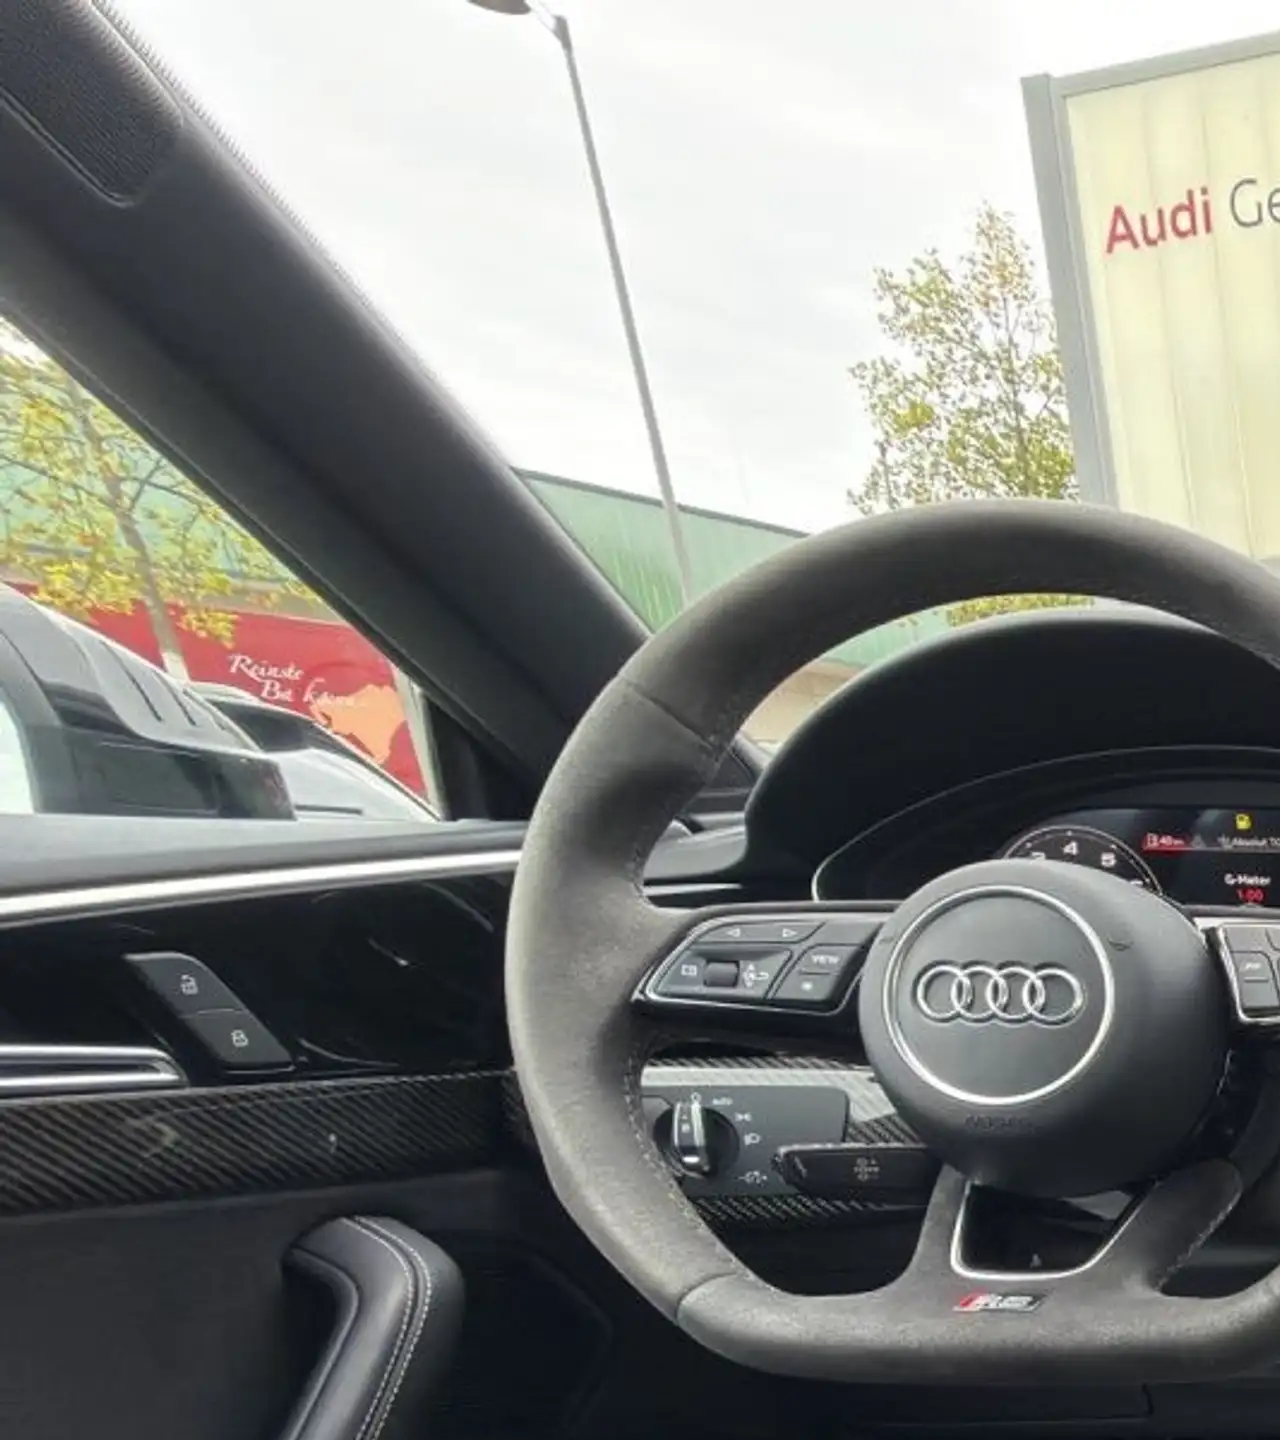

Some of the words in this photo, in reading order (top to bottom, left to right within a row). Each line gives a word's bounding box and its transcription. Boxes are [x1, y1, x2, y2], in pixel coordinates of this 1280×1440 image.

[1105, 186, 1214, 254] Audi
[1063, 841, 1079, 856] 4
[1101, 852, 1117, 867] 5
[1224, 873, 1271, 885] G-Meter
